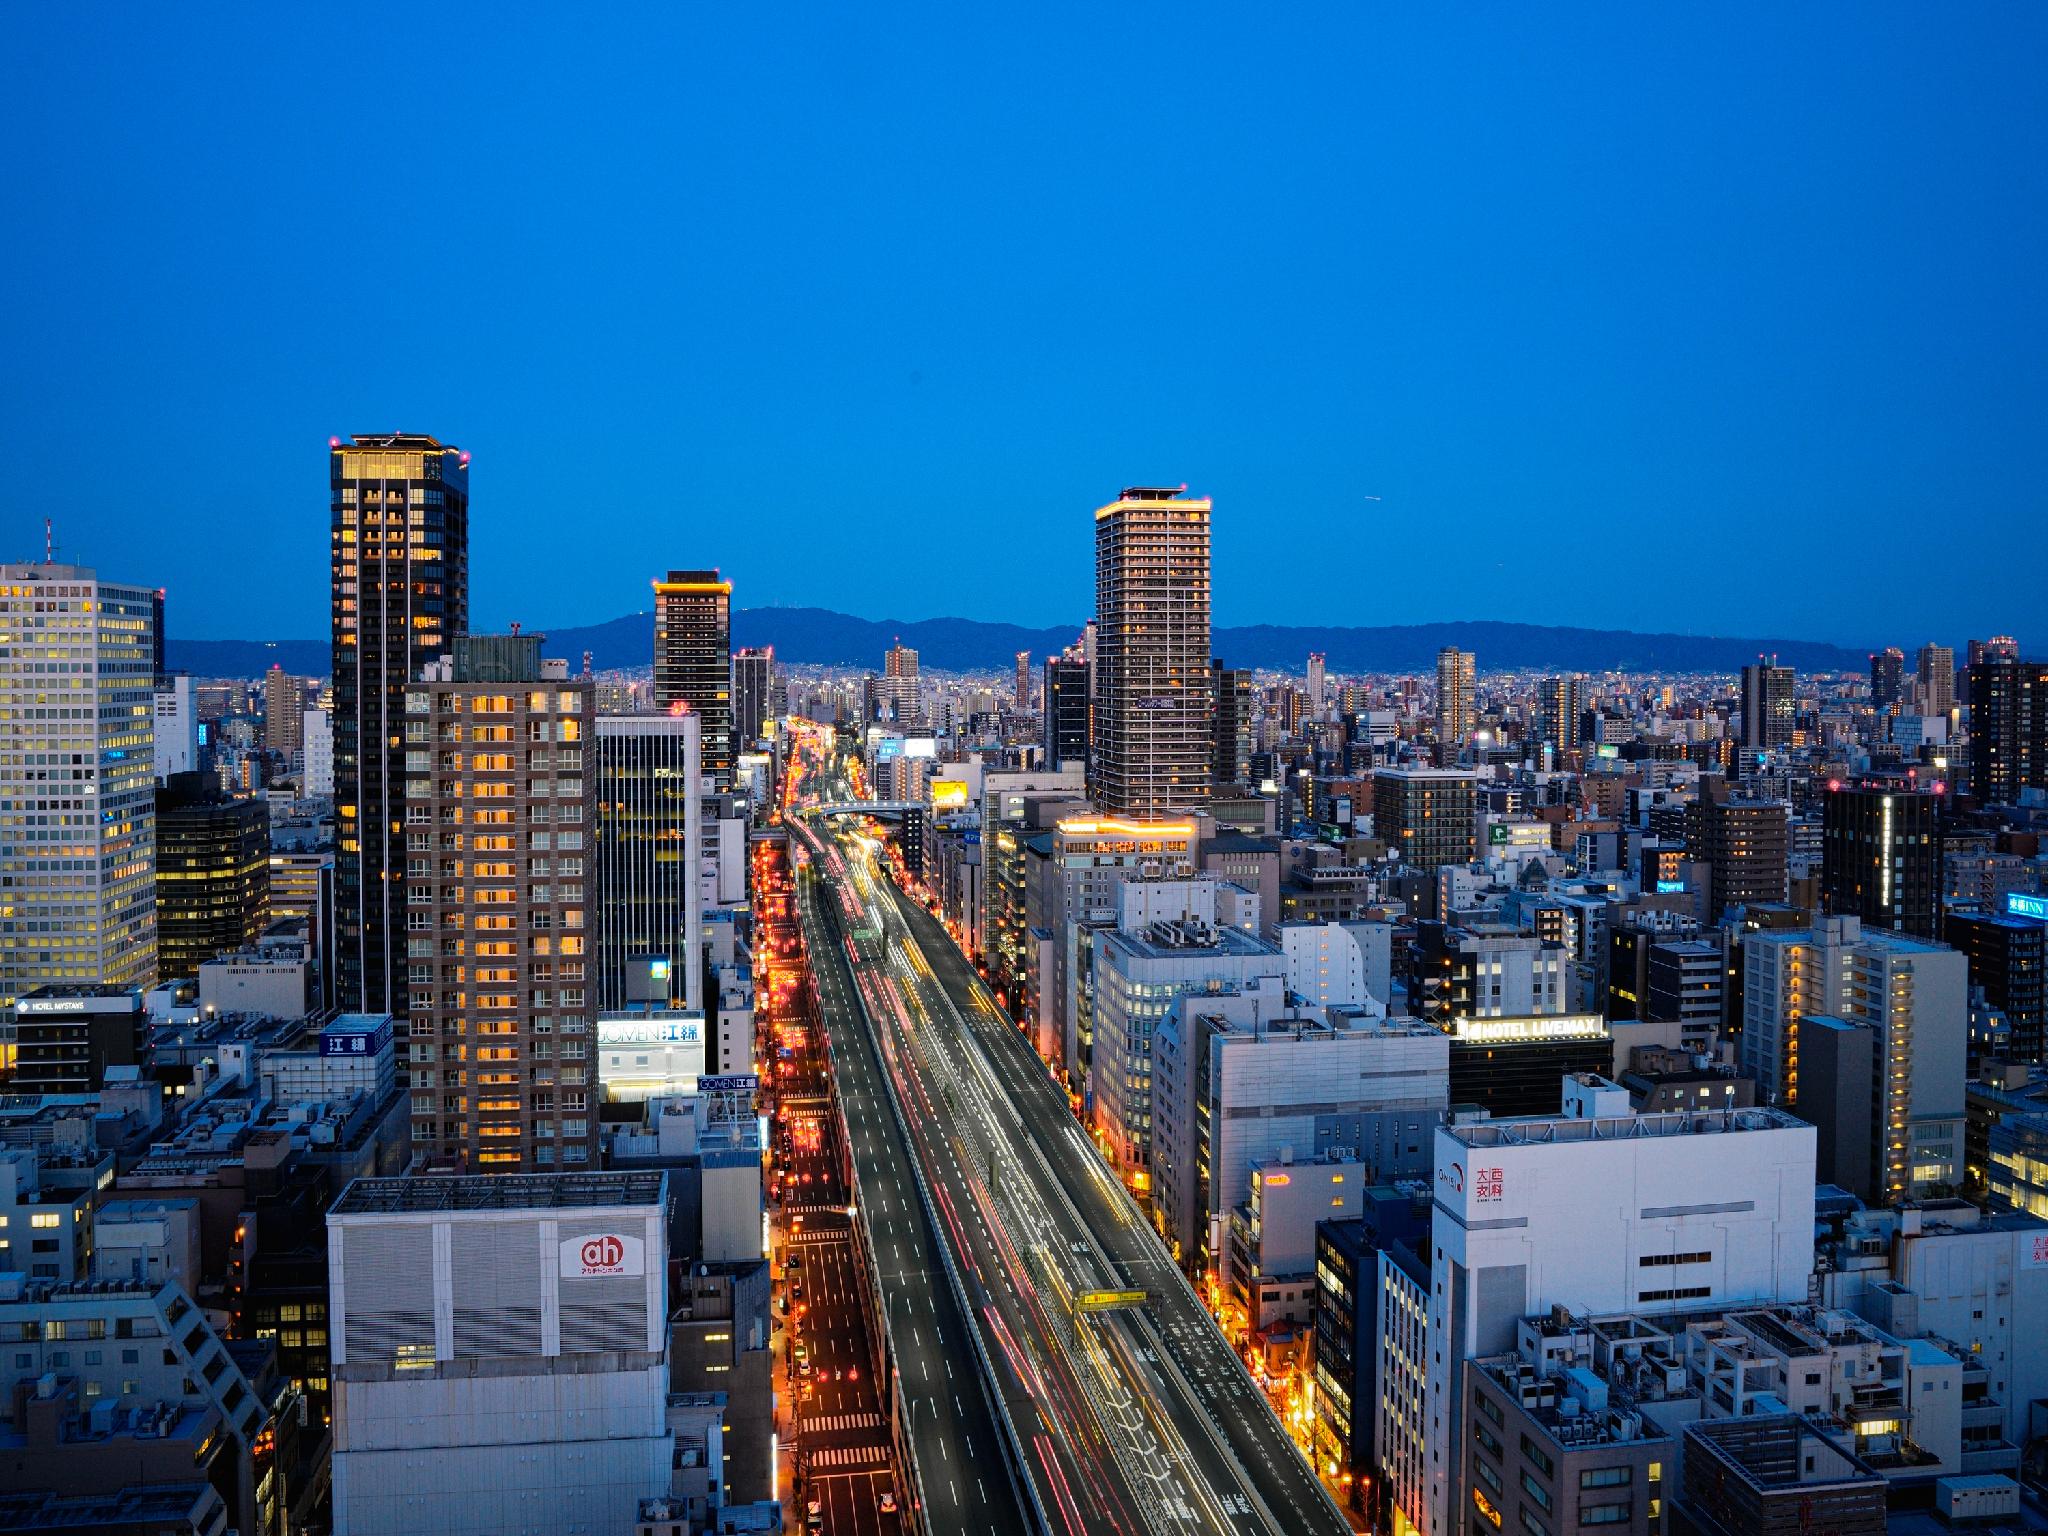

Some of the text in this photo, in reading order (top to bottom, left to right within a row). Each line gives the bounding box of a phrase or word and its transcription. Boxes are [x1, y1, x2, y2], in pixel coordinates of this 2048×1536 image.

[32, 1002, 84, 1011] HOTEL MYSTAYS
[1482, 1018, 1595, 1038] HOTEL LIVEMAX
[583, 1237, 620, 1266] ah
